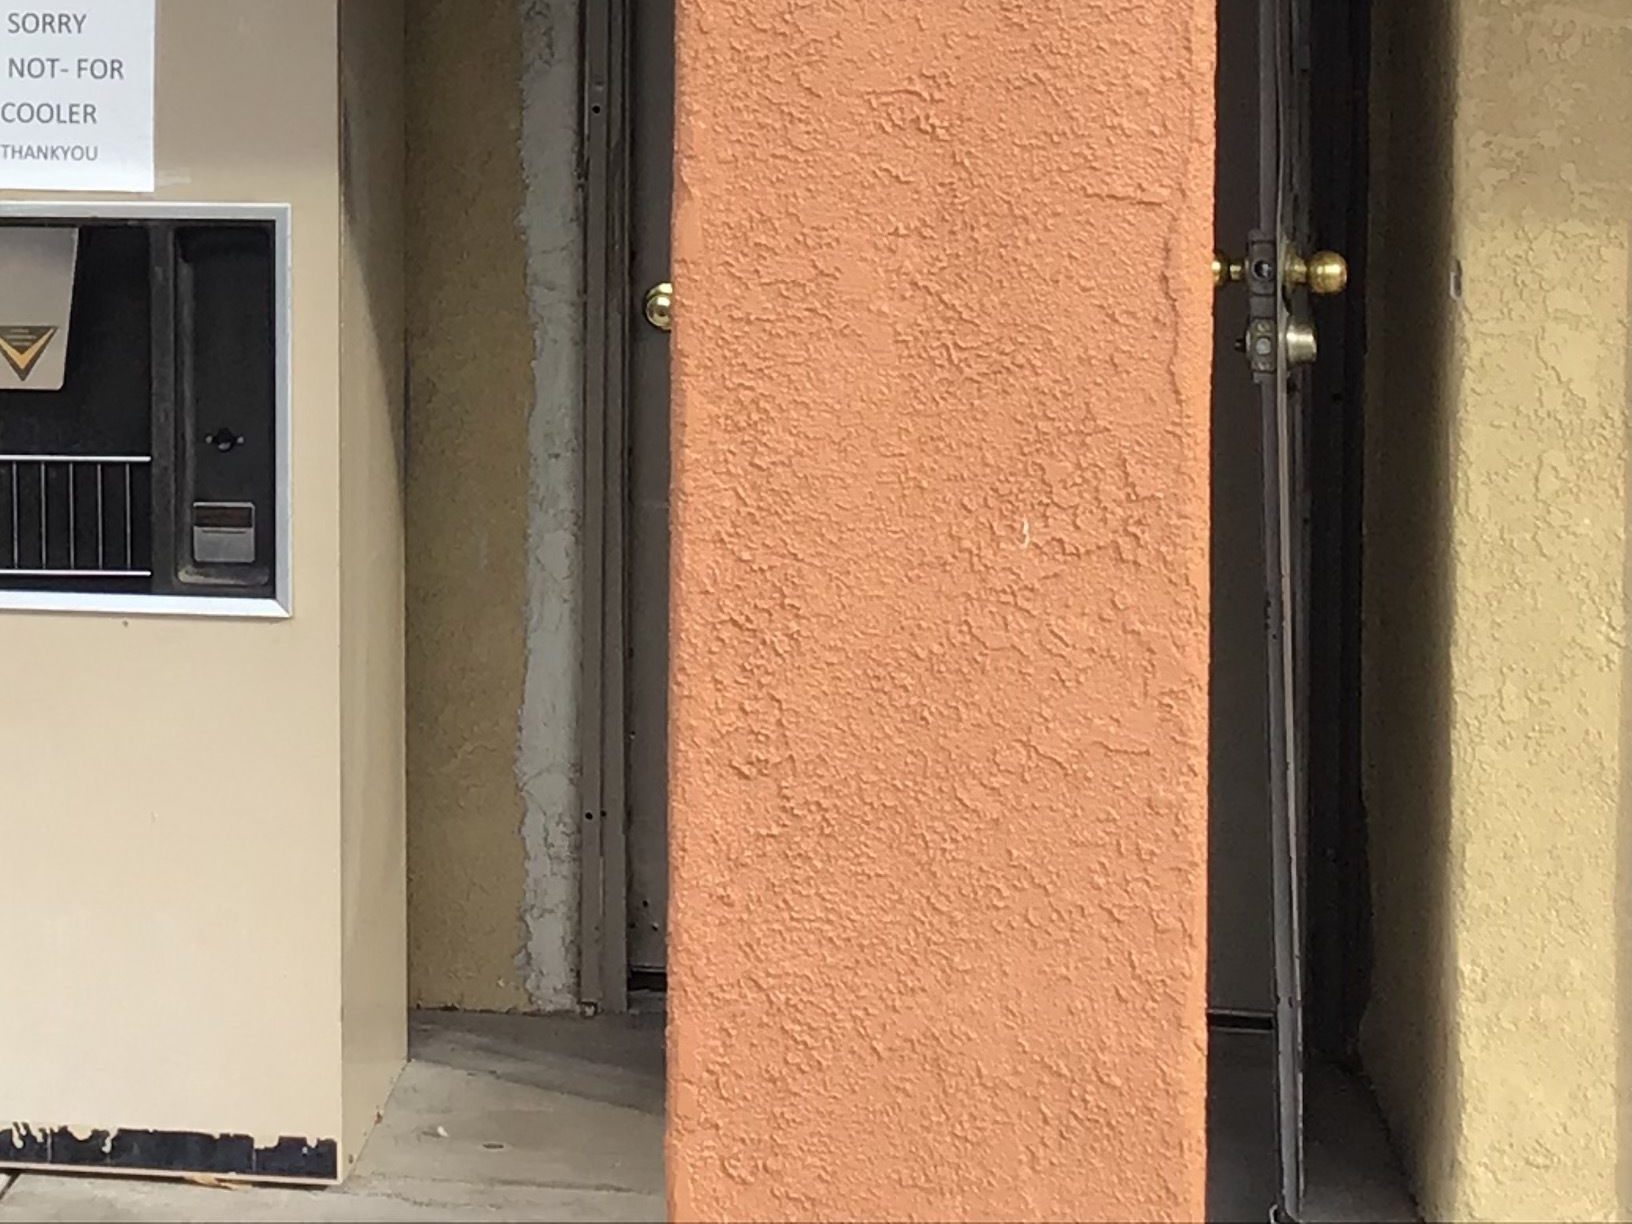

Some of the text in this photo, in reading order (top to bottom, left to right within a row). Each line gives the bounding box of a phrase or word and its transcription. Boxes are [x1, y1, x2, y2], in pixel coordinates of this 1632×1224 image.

[7, 12, 87, 34] SORRY
[7, 57, 124, 80] NOT- FOR
[0, 101, 97, 125] COOLER
[0, 143, 98, 162] THANKYOU
